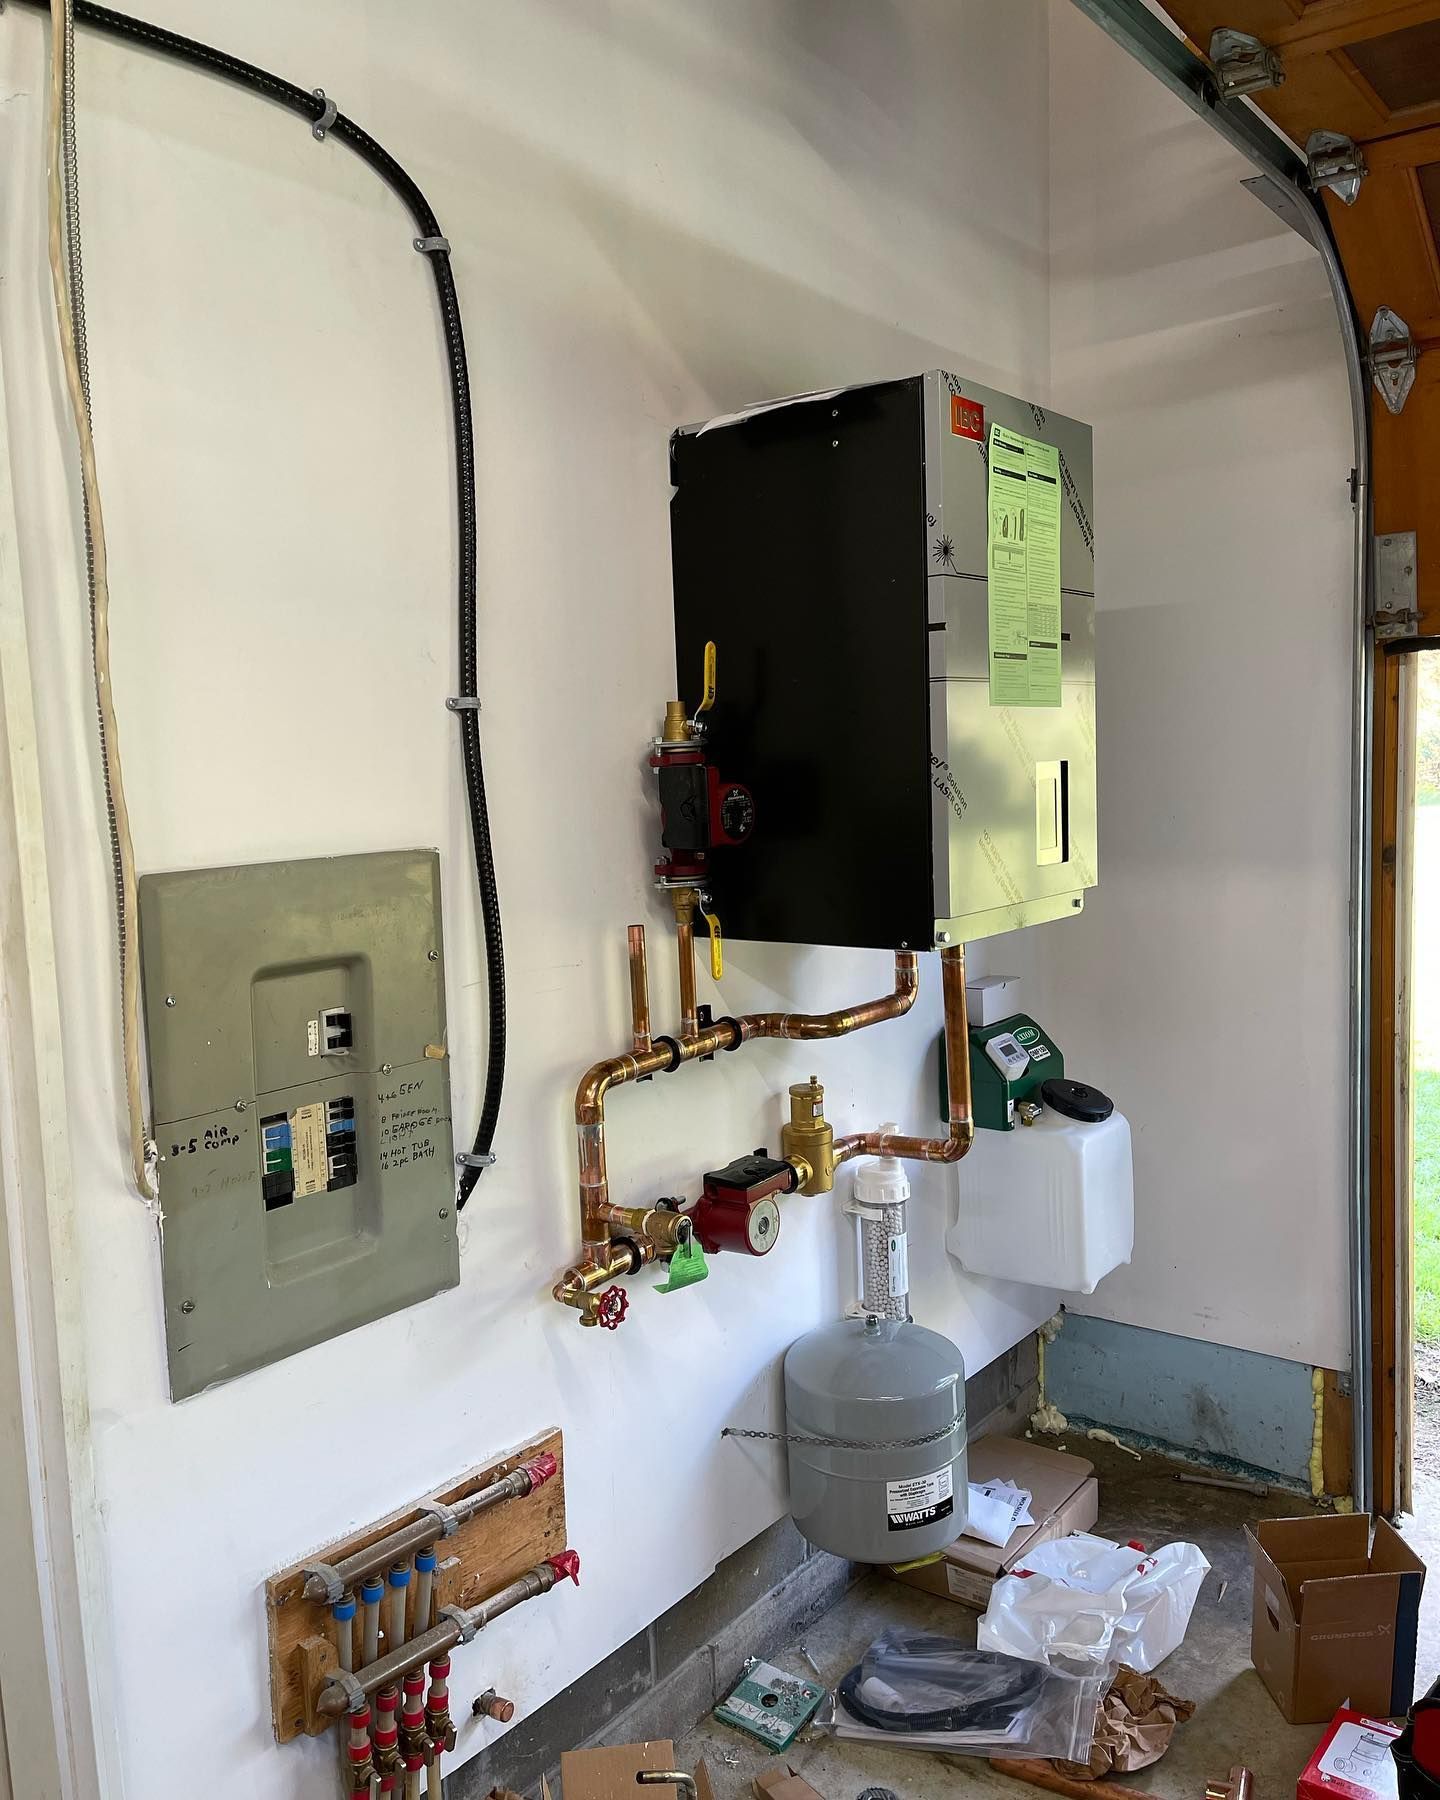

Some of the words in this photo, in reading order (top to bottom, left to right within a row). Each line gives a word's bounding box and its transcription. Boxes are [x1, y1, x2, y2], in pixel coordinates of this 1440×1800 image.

[955, 403, 981, 433] IBC
[933, 777, 955, 804] LASER
[946, 772, 968, 810] Solution
[1016, 1029, 1036, 1042] AXIOM
[381, 1115, 387, 1124] 8
[381, 1128, 390, 1137] 10
[380, 1151, 388, 1161] 14
[390, 1146, 407, 1157] HOT
[412, 1139, 430, 1152] TUB
[381, 1161, 389, 1170] 16
[412, 1146, 435, 1161] BATH
[903, 1506, 937, 1523] WATTS
